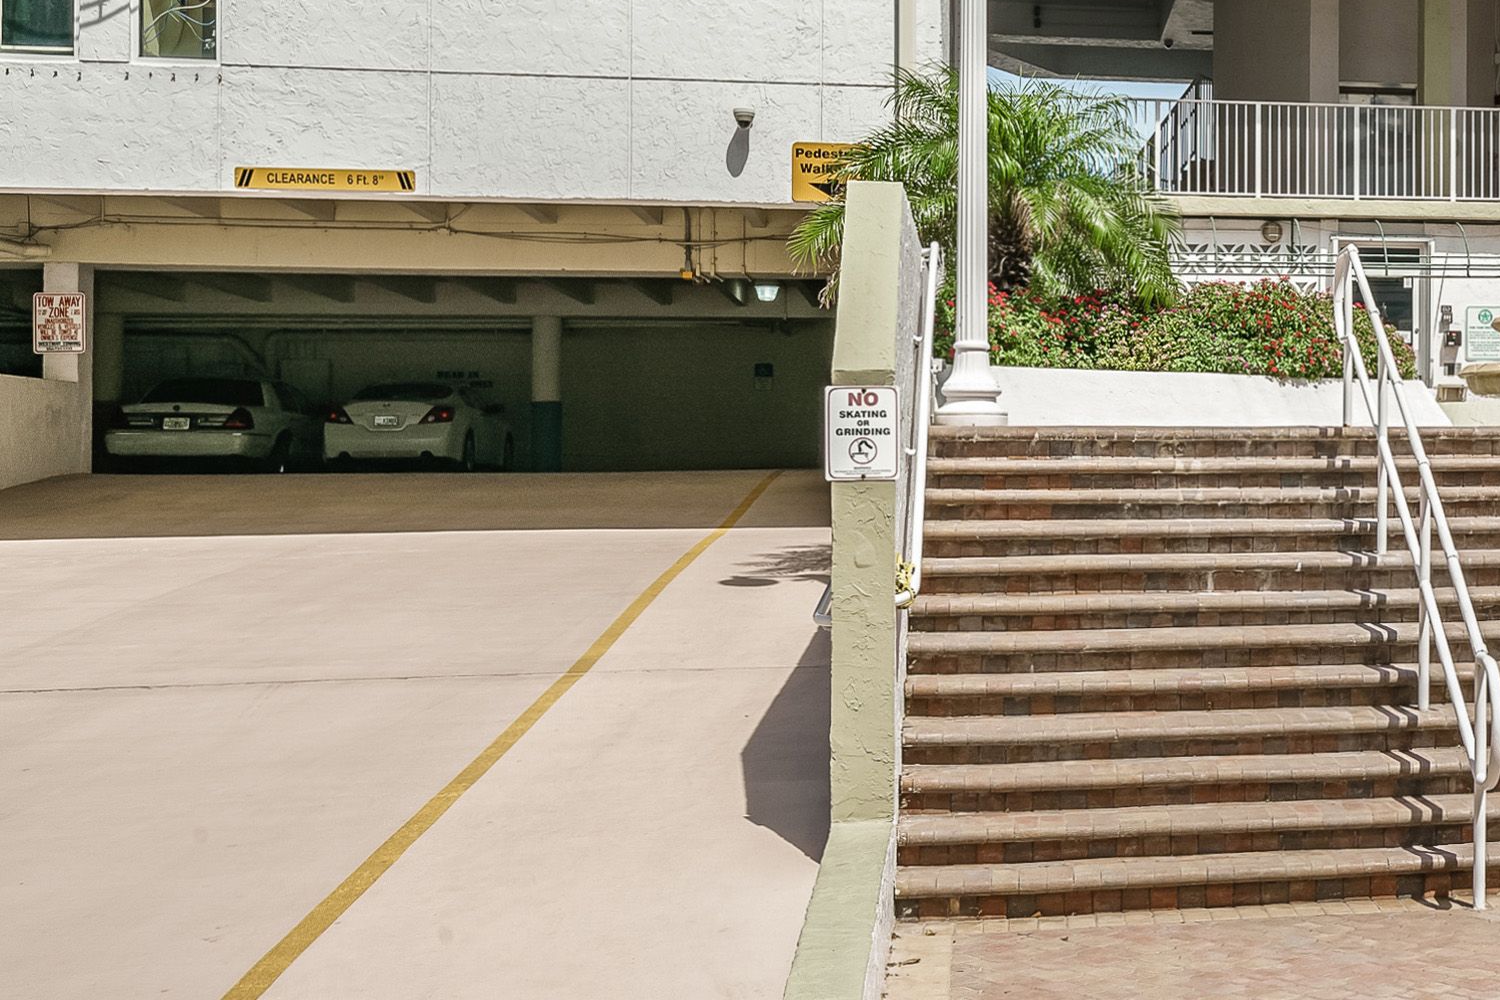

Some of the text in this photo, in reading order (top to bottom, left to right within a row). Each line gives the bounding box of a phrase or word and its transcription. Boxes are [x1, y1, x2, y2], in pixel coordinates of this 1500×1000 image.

[266, 172, 335, 185] CLEARANCE
[347, 174, 353, 185] 6
[356, 175, 369, 186] Ft.
[38, 296, 81, 307] TOW AWAY
[48, 307, 69, 318] ZONE
[848, 392, 878, 406] NO
[839, 410, 887, 418] SKATING
[835, 428, 891, 436] GRINDING
